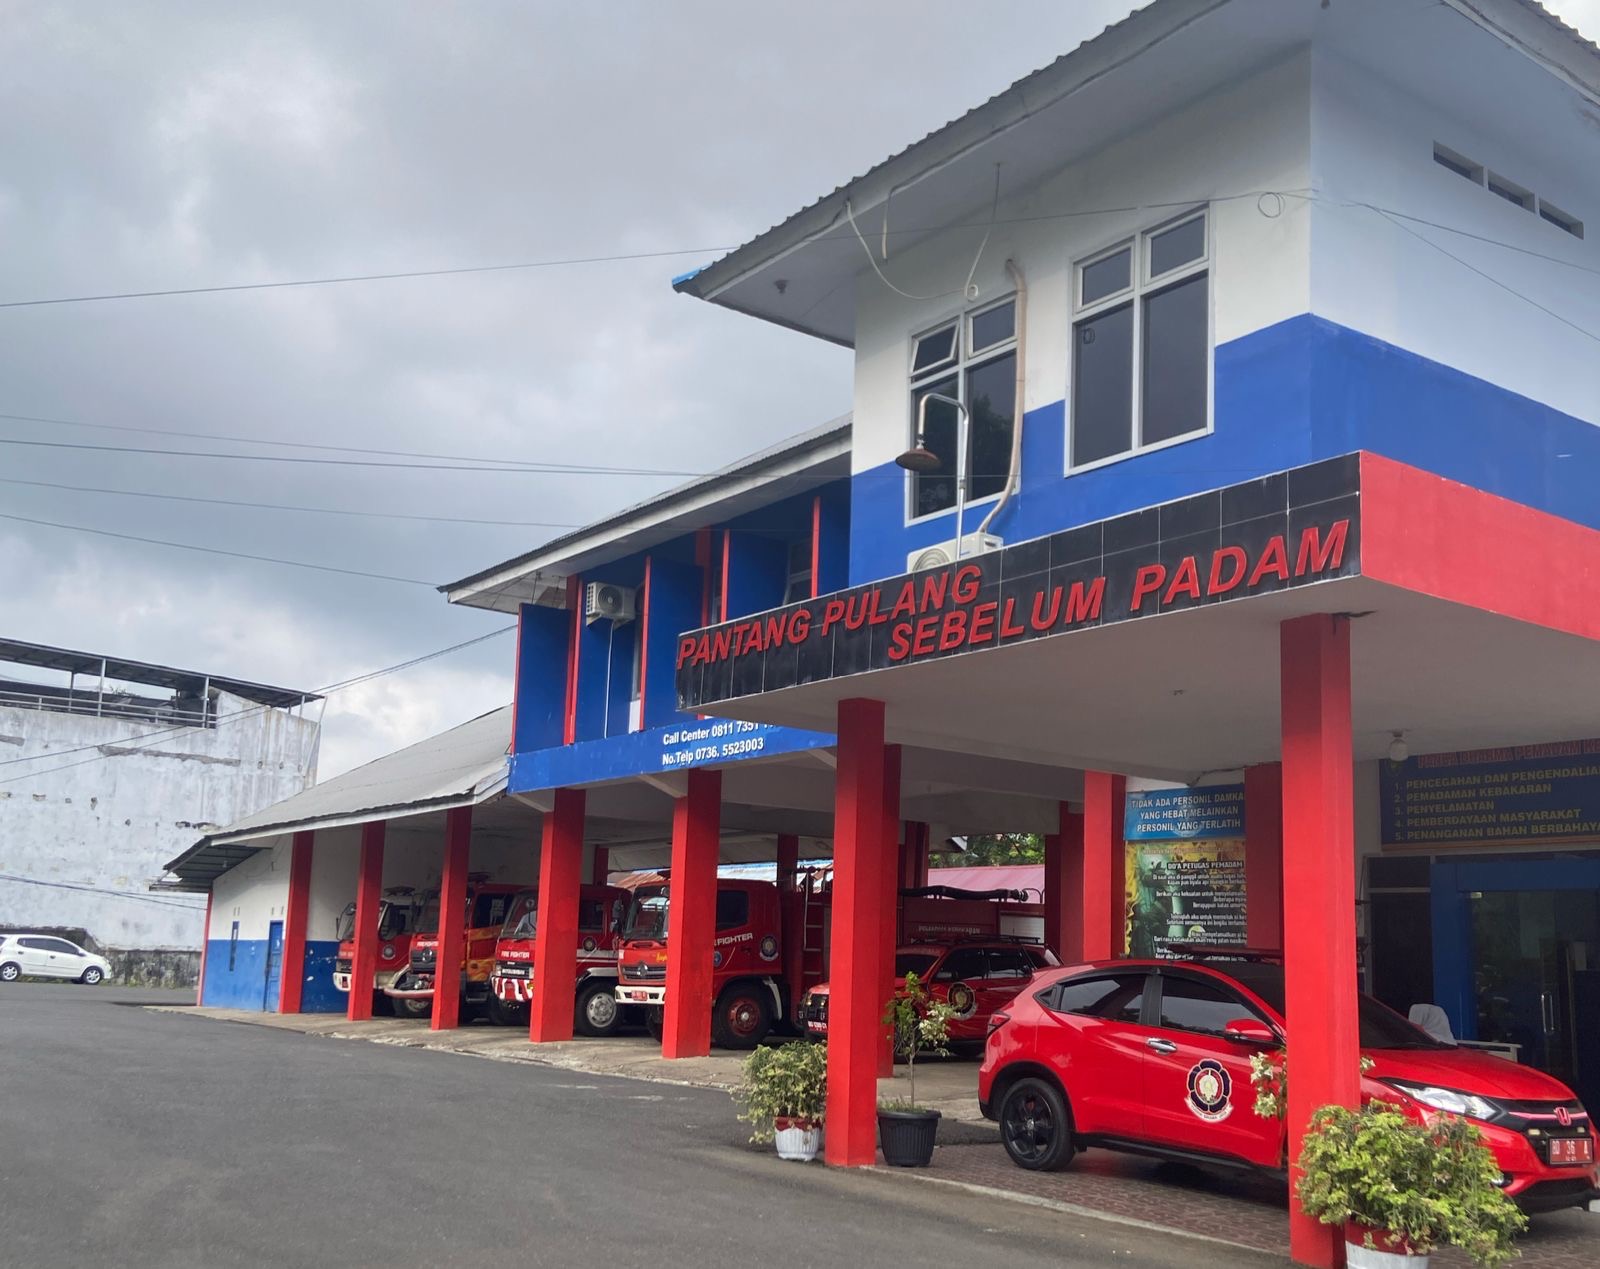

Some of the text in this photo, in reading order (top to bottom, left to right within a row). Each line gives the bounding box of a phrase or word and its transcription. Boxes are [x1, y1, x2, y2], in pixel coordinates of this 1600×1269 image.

[887, 519, 1349, 661] SEBELUM PADAM
[676, 565, 982, 670] PANTANG PULANG
[663, 731, 680, 745] Call
[681, 728, 710, 743] Center
[711, 722, 733, 737] 0811
[722, 737, 764, 756] 5523003
[1406, 775, 1481, 789] PENCEGAHAN
[1484, 773, 1508, 784] DAN
[1511, 765, 1600, 782] PENGENDALIA
[1131, 792, 1244, 808] TIDAK ADA PERSONIL DAMKA
[1406, 789, 1476, 802] PEMADAMAN
[1479, 783, 1552, 796] KEBAKARAN
[1140, 806, 1239, 820] YANG HEBAT MELAINKAN
[1406, 800, 1494, 815] PENYELAMATAN
[1137, 818, 1240, 832] PERSONIL YANG TERLATIH
[1407, 814, 1497, 827] PEMBERDAYAAN
[1499, 808, 1582, 823] MASYARAKAT
[1407, 828, 1483, 840] PENANGANAN
[1486, 825, 1527, 836] BAHAN
[717, 932, 754, 946] FIGHTER
